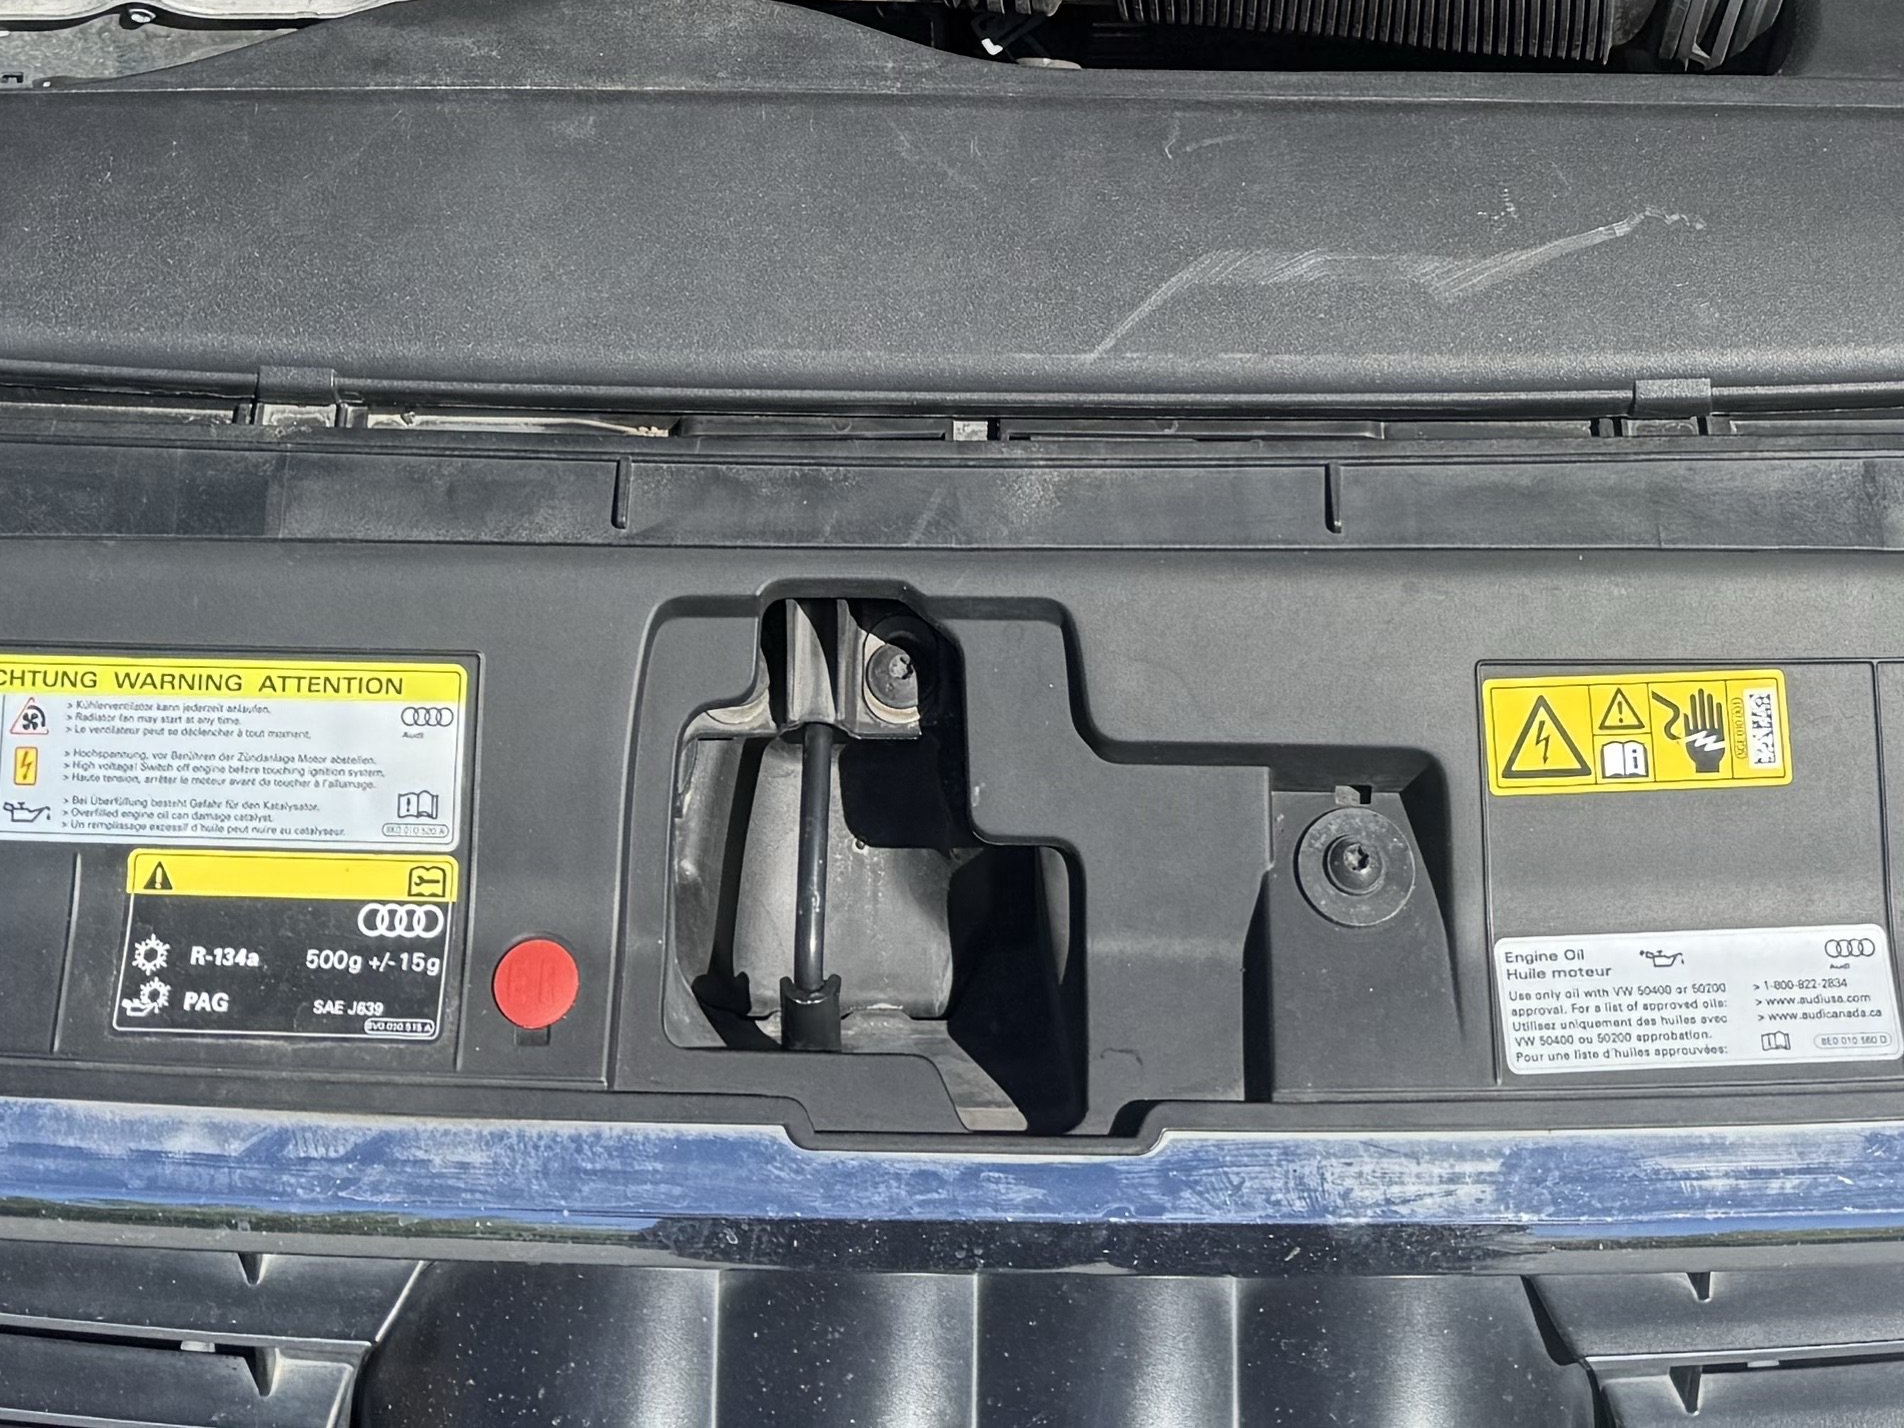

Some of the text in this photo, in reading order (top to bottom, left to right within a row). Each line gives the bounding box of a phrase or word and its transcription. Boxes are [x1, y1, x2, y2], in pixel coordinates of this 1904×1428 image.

[114, 670, 243, 694] WARNING
[258, 673, 404, 696] ATTENTION
[156, 702, 181, 712] kann
[74, 712, 242, 726] Radiator fan may start at any time.
[74, 724, 87, 734] Le
[89, 725, 140, 735] ventilateur
[142, 727, 165, 737] peut
[237, 729, 243, 738] à
[245, 729, 265, 738] tout
[151, 752, 168, 760] vor
[218, 753, 235, 762] der
[297, 754, 328, 764] Motor
[72, 761, 96, 771] High
[140, 761, 174, 772] Switch
[176, 763, 190, 772] off
[192, 764, 225, 775] engine
[228, 765, 261, 775] before
[262, 766, 305, 778] touching
[308, 767, 346, 778] ignition
[71, 773, 101, 782] Haute
[180, 776, 189, 785] le
[191, 777, 226, 786] moteur
[228, 777, 257, 787] avant
[258, 778, 271, 787] de
[273, 778, 311, 788] toucher
[314, 779, 320, 788] à
[71, 795, 88, 805] Bei
[150, 798, 188, 808] besteht
[189, 798, 223, 809] Gefahr
[225, 799, 239, 809] für
[241, 800, 261, 810] den
[70, 807, 119, 818] Overfilled
[120, 810, 155, 820] engine
[156, 810, 169, 820] oil
[171, 812, 189, 820] can
[191, 811, 232, 823] damage
[70, 819, 292, 836] Un remplissage excessif peut nuire au
[190, 946, 260, 967] R-134a
[305, 949, 363, 975] 500g
[1504, 949, 1585, 965] Engine Oil
[1506, 966, 1612, 981] Huile moteur
[1763, 977, 1848, 991] 1-800-822-2834
[1509, 989, 1532, 1002] Use
[1535, 988, 1561, 1002] only
[1565, 988, 1580, 999] oil
[1584, 987, 1609, 999] with
[1612, 986, 1634, 997] VW
[1637, 984, 1672, 996] 50400
[1676, 986, 1688, 995] or
[1765, 993, 1871, 1006] www.audiusa.com
[183, 991, 384, 1016] PAG SAE J639
[1511, 998, 1728, 1018] approval. For a list of approved oils:
[1767, 1008, 1882, 1022] www.audicanada.ca
[1512, 1014, 1728, 1033] Utilisez uniquement des huiles avec
[1515, 1030, 1712, 1048] VW 50400 ou 50200 approbation.
[1841, 1036, 1858, 1045] 010
[1516, 1044, 1729, 1063] Pour une liste approuvées:
